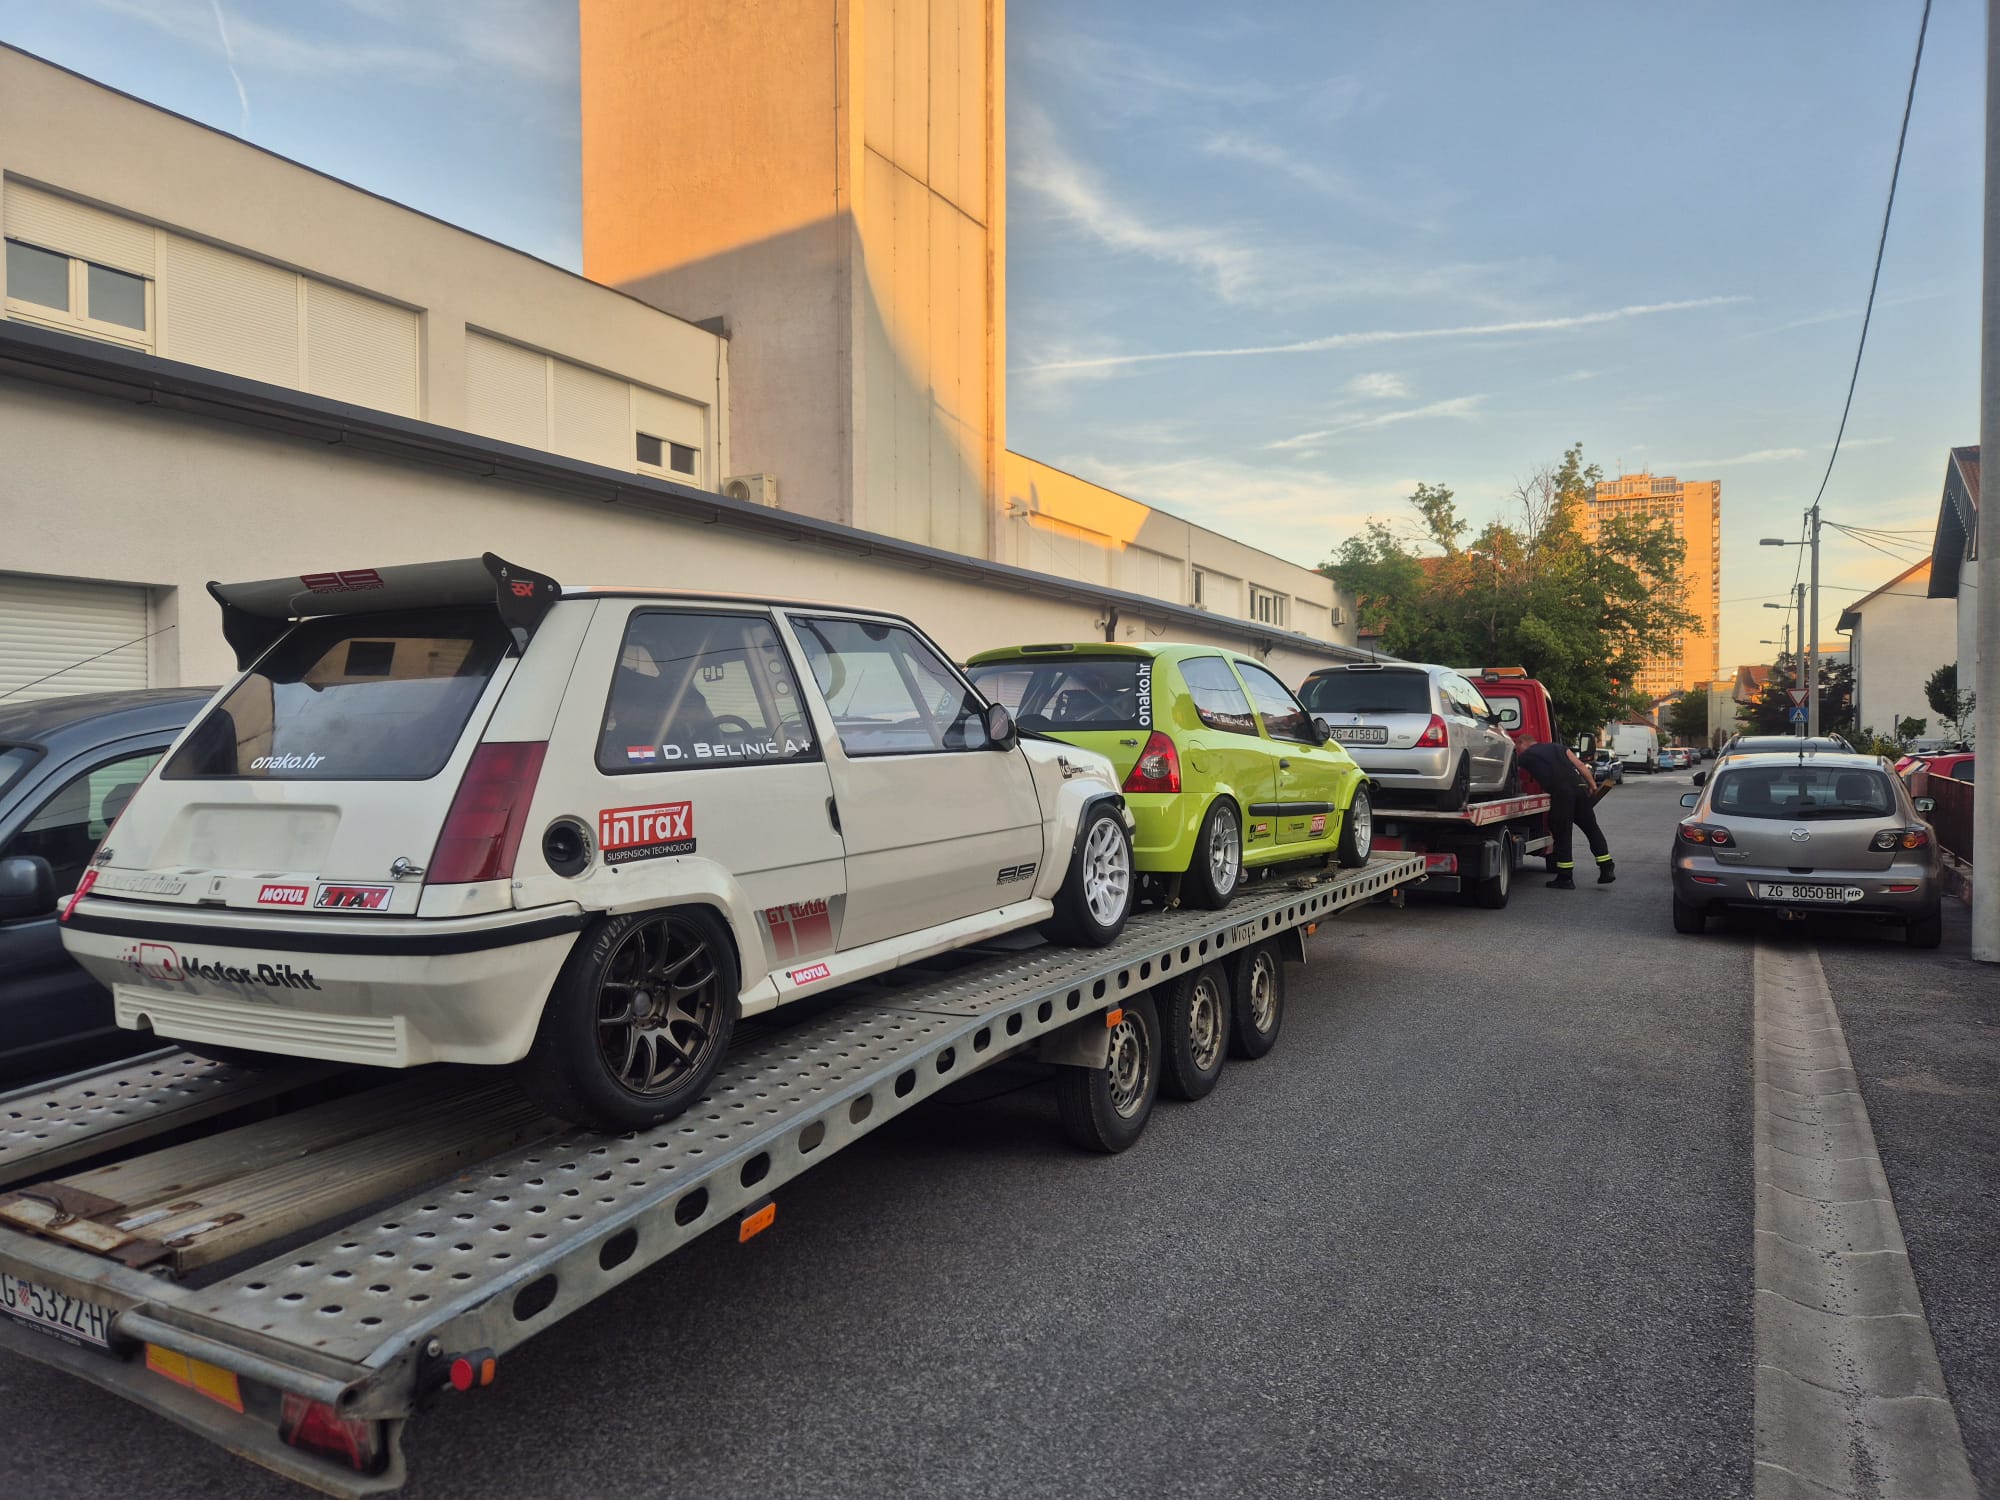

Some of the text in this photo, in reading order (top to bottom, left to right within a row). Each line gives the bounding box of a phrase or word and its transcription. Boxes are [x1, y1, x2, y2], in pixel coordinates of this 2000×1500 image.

[311, 581, 385, 594] MOTORSPORT
[1135, 663, 1151, 726] onako.hr
[1331, 729, 1342, 739] ZG
[662, 744, 688, 760] D.
[693, 738, 779, 758] BELINIĆ
[250, 752, 326, 769] onako.hr
[607, 842, 694, 862] SUSPENSION TECHNOLOGY
[260, 887, 304, 902] MOTUL
[1767, 885, 1783, 897] ZG
[1847, 890, 1862, 898] HR
[181, 956, 322, 991] Motor-Diht
[794, 965, 828, 983] MOTUL
[0, 1271, 16, 1308] G
